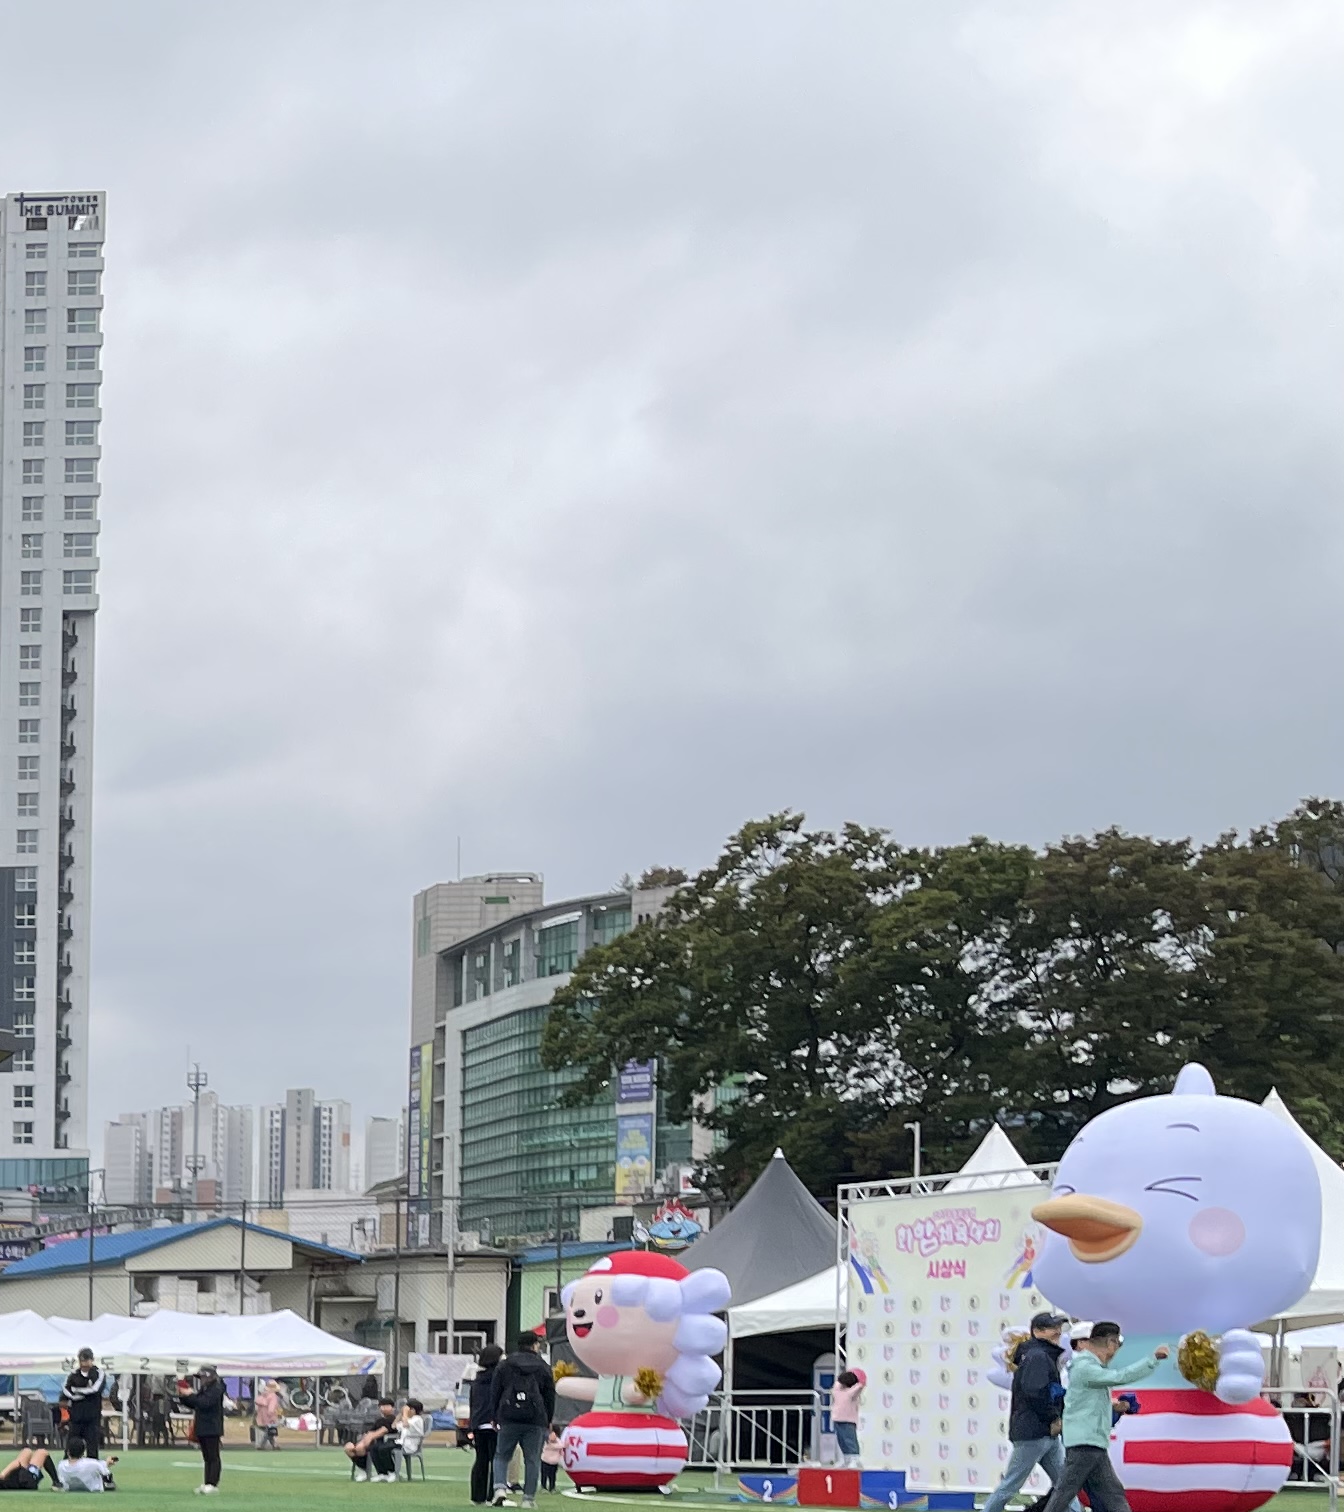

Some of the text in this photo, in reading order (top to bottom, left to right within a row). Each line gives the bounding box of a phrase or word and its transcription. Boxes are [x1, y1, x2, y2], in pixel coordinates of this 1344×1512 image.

[46, 203, 99, 216] SUMMIT
[762, 1479, 773, 1503] 2
[824, 1474, 833, 1494] 1
[888, 1490, 898, 1510] 3
